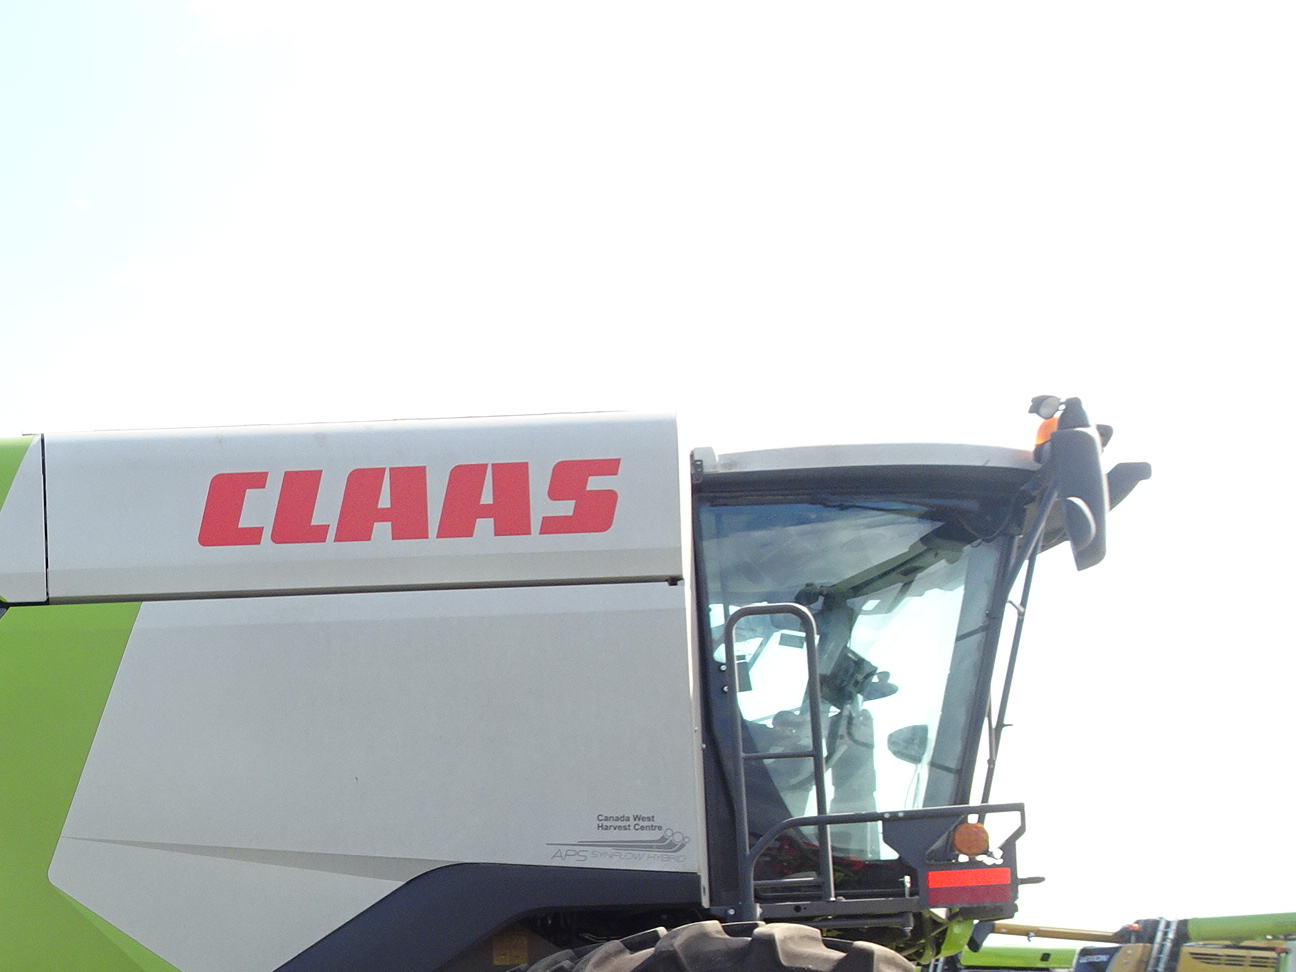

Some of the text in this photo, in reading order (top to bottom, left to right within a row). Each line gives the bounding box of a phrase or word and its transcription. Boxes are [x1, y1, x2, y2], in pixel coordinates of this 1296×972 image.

[197, 458, 621, 547] CLAAS
[597, 814, 655, 822] Canada West
[597, 823, 663, 831] Harvest Centre
[551, 849, 687, 863] APS SYNFLOW HYBRID
